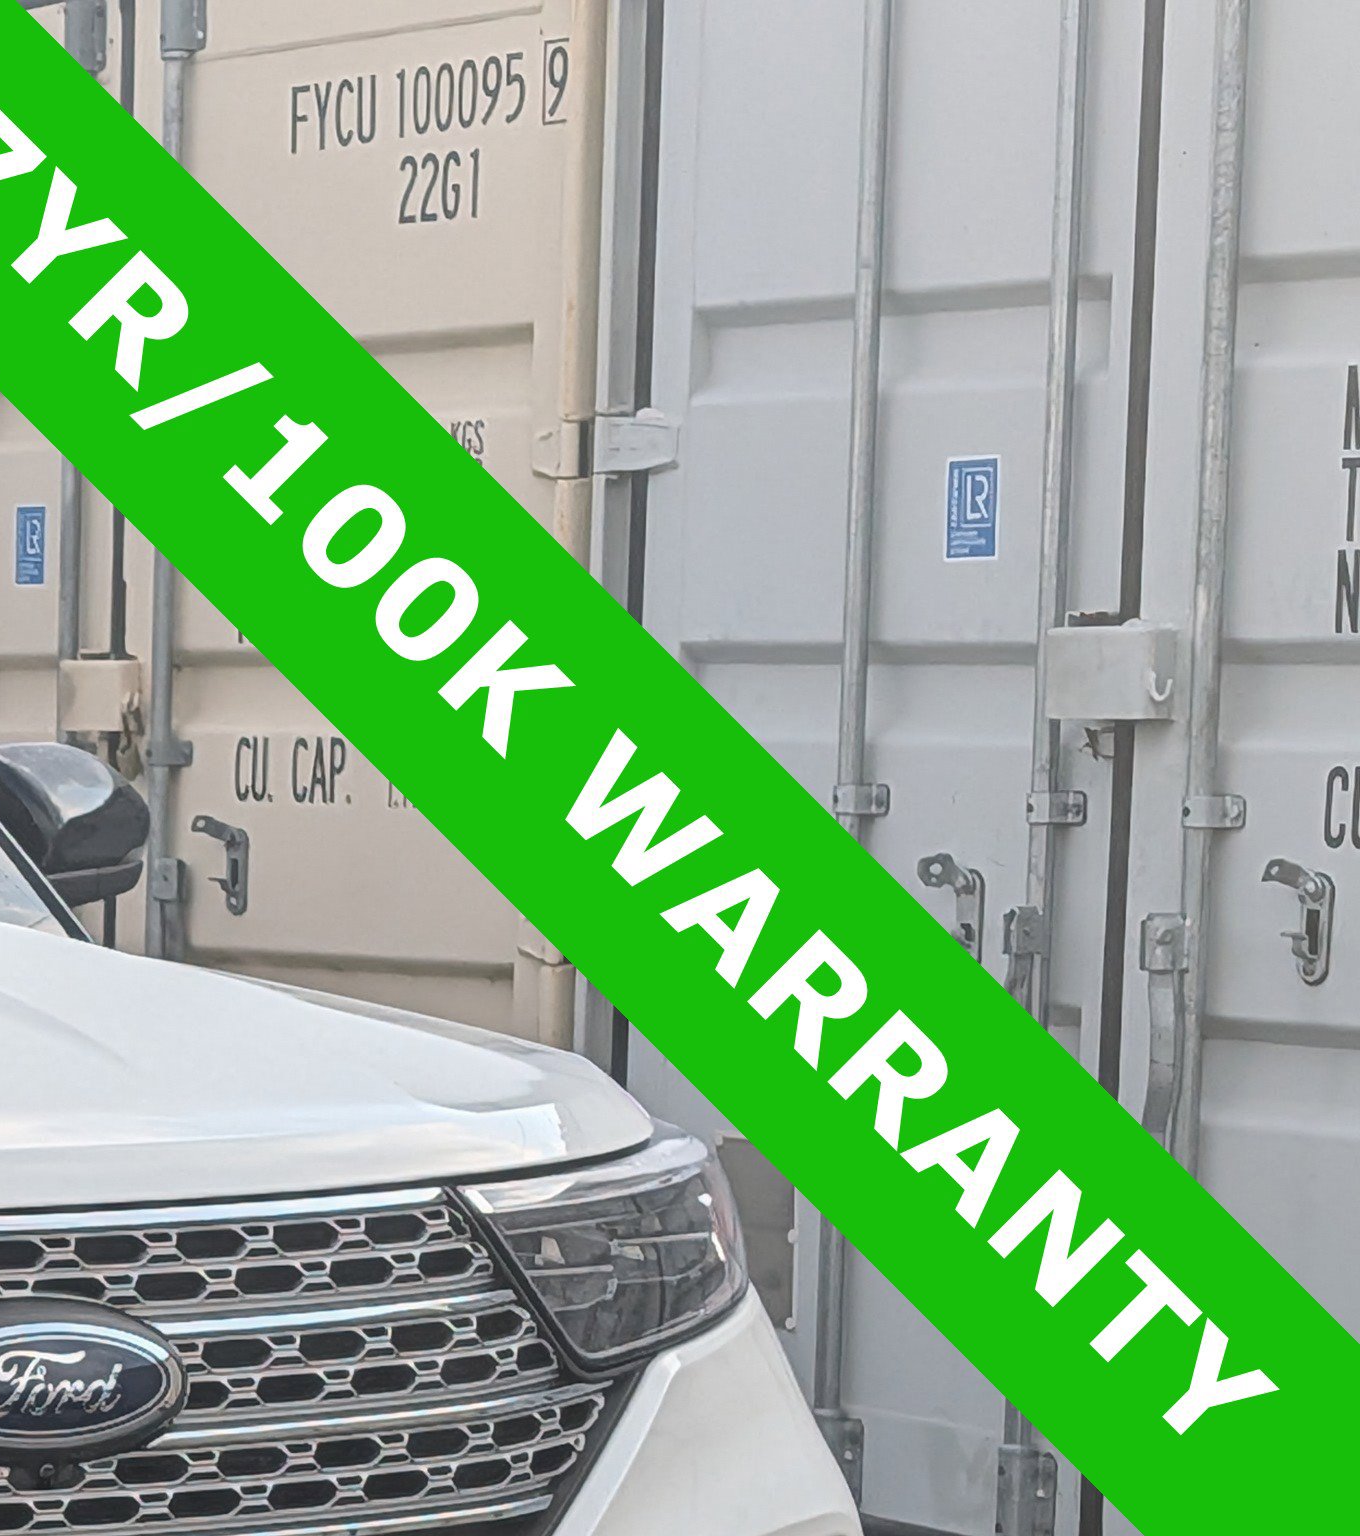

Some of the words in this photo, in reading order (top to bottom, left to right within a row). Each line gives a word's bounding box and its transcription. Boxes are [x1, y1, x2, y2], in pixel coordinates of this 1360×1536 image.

[290, 73, 377, 155] FYCU
[395, 51, 527, 140] 100095
[547, 45, 570, 118] 9
[397, 147, 481, 225] 22G1
